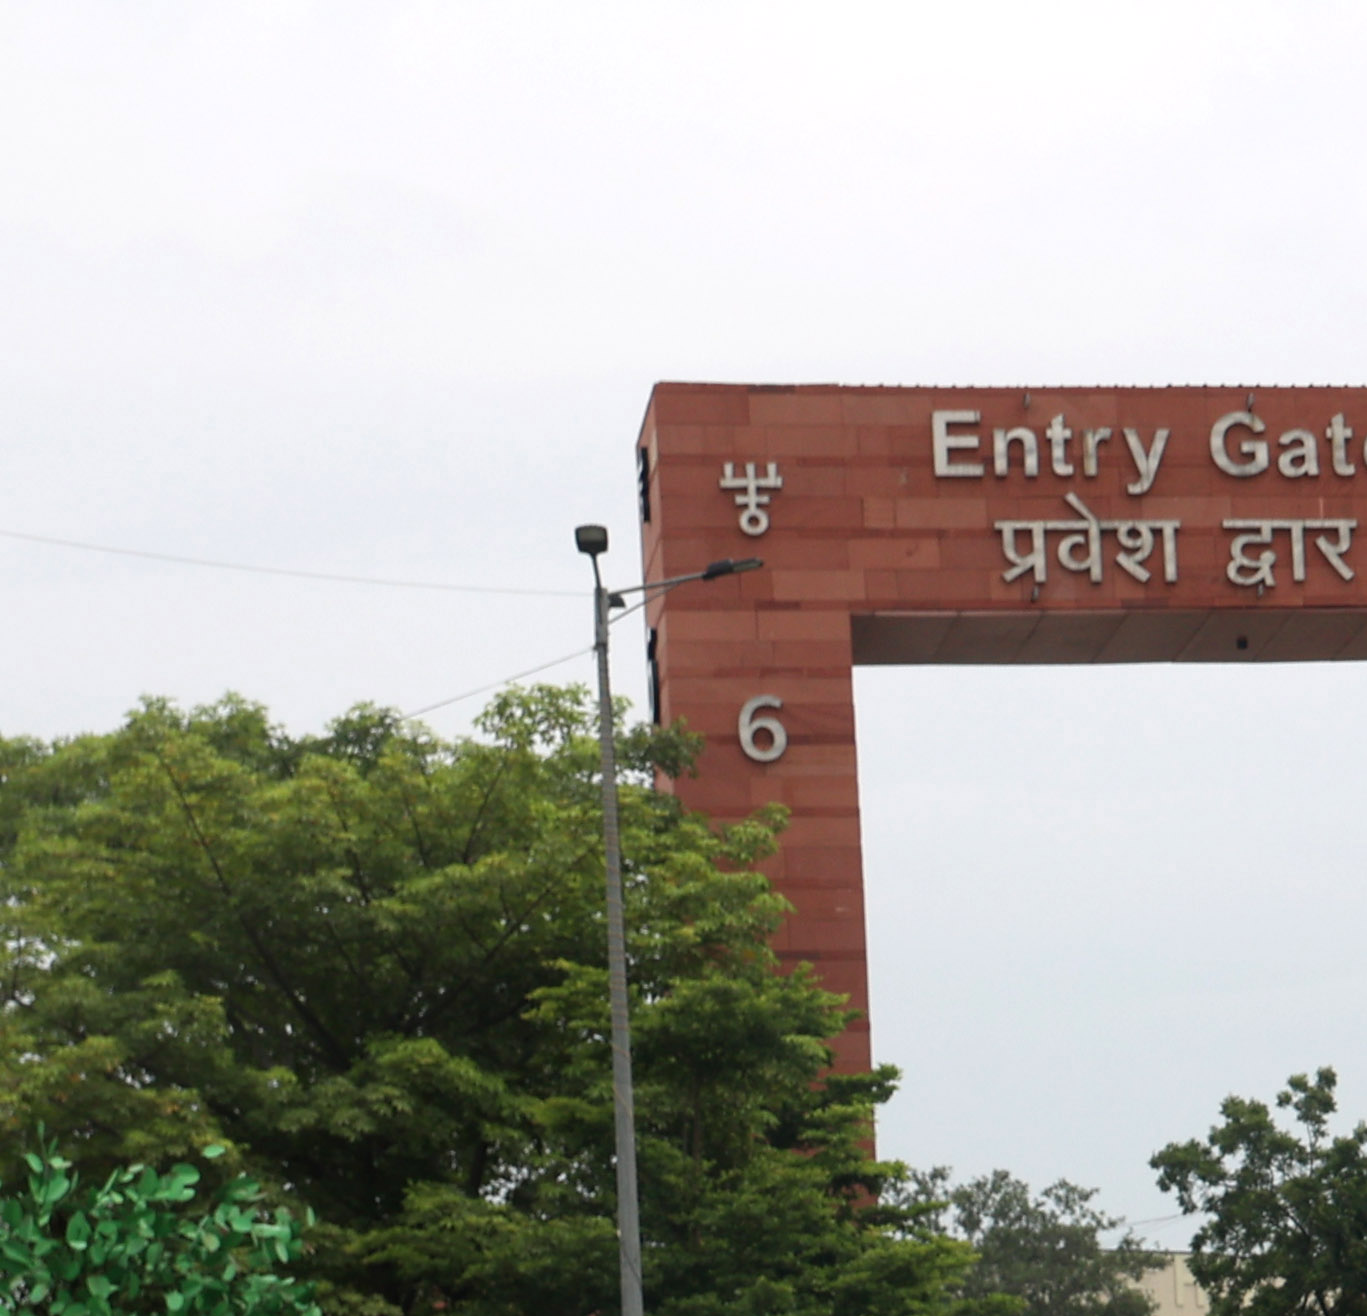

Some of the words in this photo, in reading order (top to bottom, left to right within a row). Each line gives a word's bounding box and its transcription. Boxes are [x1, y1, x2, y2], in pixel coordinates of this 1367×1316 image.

[931, 409, 1171, 496] Entry
[994, 492, 1181, 585] प्रवेश
[1222, 518, 1359, 587] द्वार
[737, 694, 788, 763] 6
